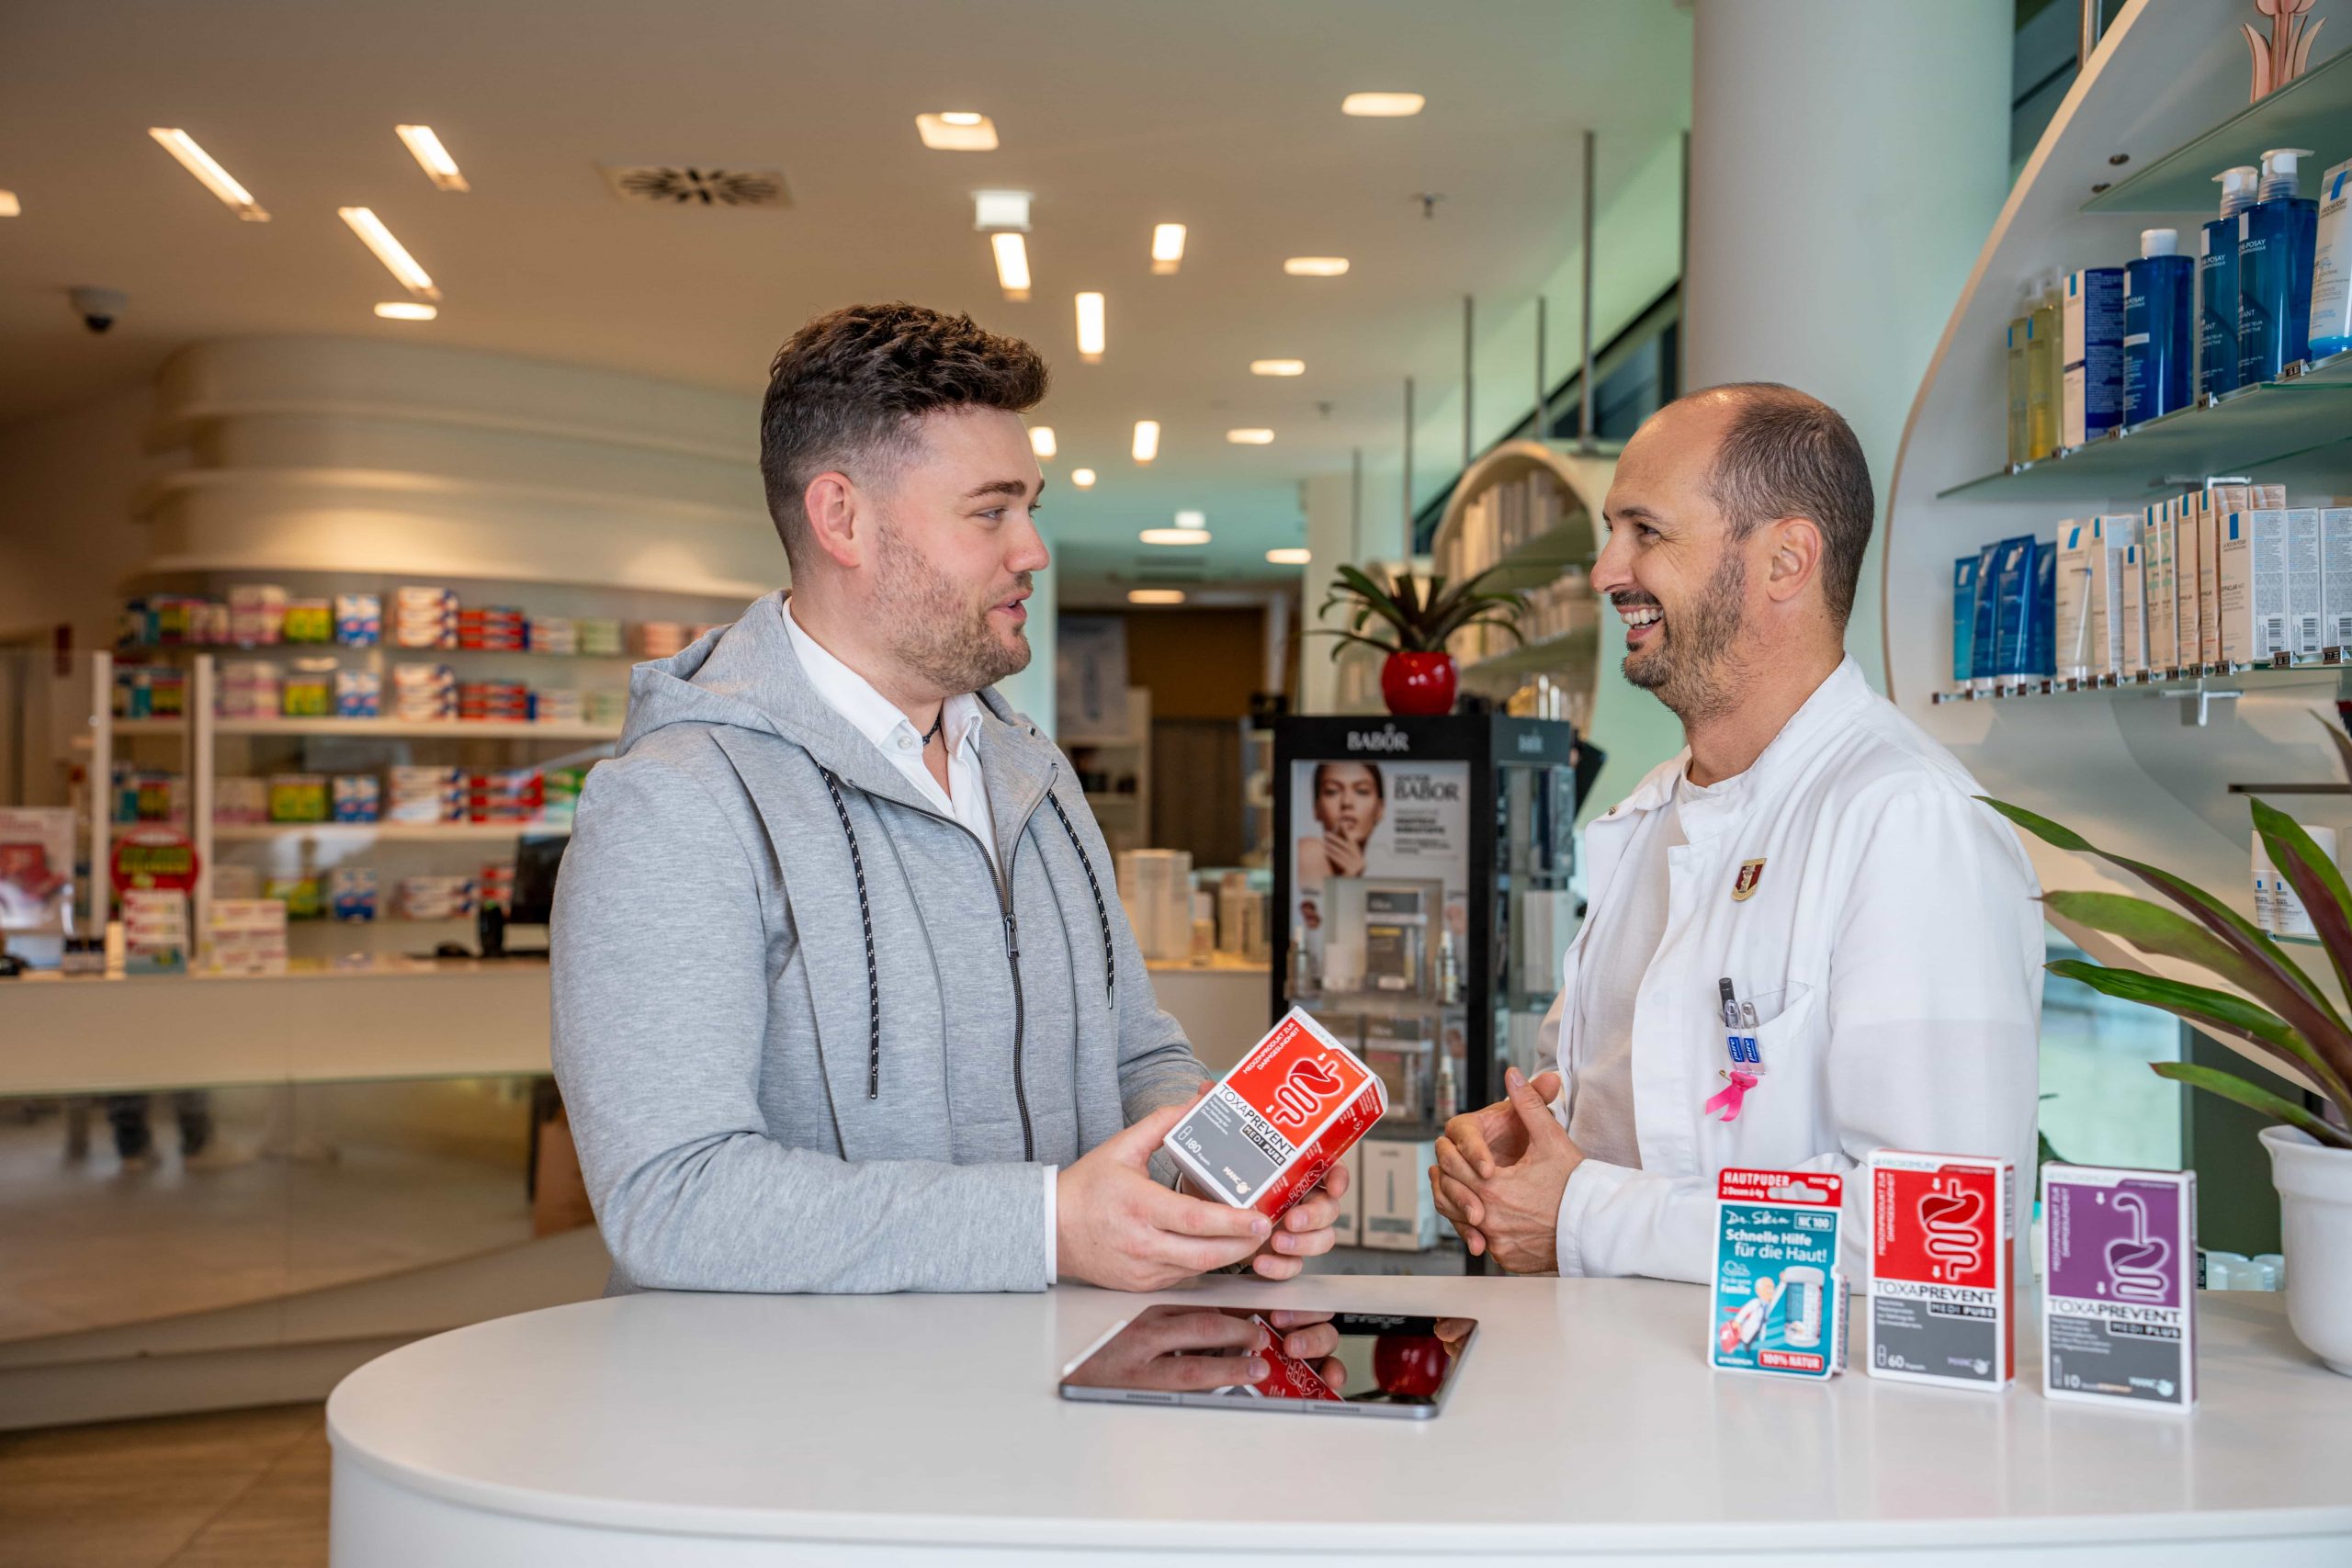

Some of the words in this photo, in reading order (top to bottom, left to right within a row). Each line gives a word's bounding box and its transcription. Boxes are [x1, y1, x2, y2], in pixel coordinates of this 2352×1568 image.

[1347, 729, 1409, 751] BABOR
[1395, 781, 1460, 802] BABOR
[1243, 1032, 1284, 1074] MEDIZINPRODUKT
[1283, 1022, 1295, 1034] ZUR
[1257, 1027, 1300, 1071] DARMGESUNDHEIT
[1219, 1084, 1295, 1156] TOXAPREVENT
[1184, 1137, 1202, 1154] 180
[1244, 1126, 1264, 1145] MEDI
[1262, 1144, 1285, 1165] PURE
[1724, 1171, 1790, 1187] HAUTPUDER
[1725, 1229, 1780, 1244] Schnelle
[1781, 1232, 1813, 1247] Hilfe
[1735, 1242, 1757, 1258] für
[1758, 1244, 1783, 1259] die
[1785, 1246, 1827, 1263] Haut!
[1873, 1281, 1996, 1304] TOXAPREVENT
[1932, 1303, 1961, 1314] MEDI
[1962, 1306, 1995, 1318] PURE
[2050, 1299, 2180, 1323] TOXAPREVENT
[2112, 1322, 2143, 1334] MEDI
[2145, 1325, 2179, 1337] PLUS
[1763, 1353, 1788, 1366] 100%
[1788, 1355, 1820, 1369] NATUR
[1888, 1355, 1905, 1369] 60
[2064, 1373, 2081, 1388] 10
